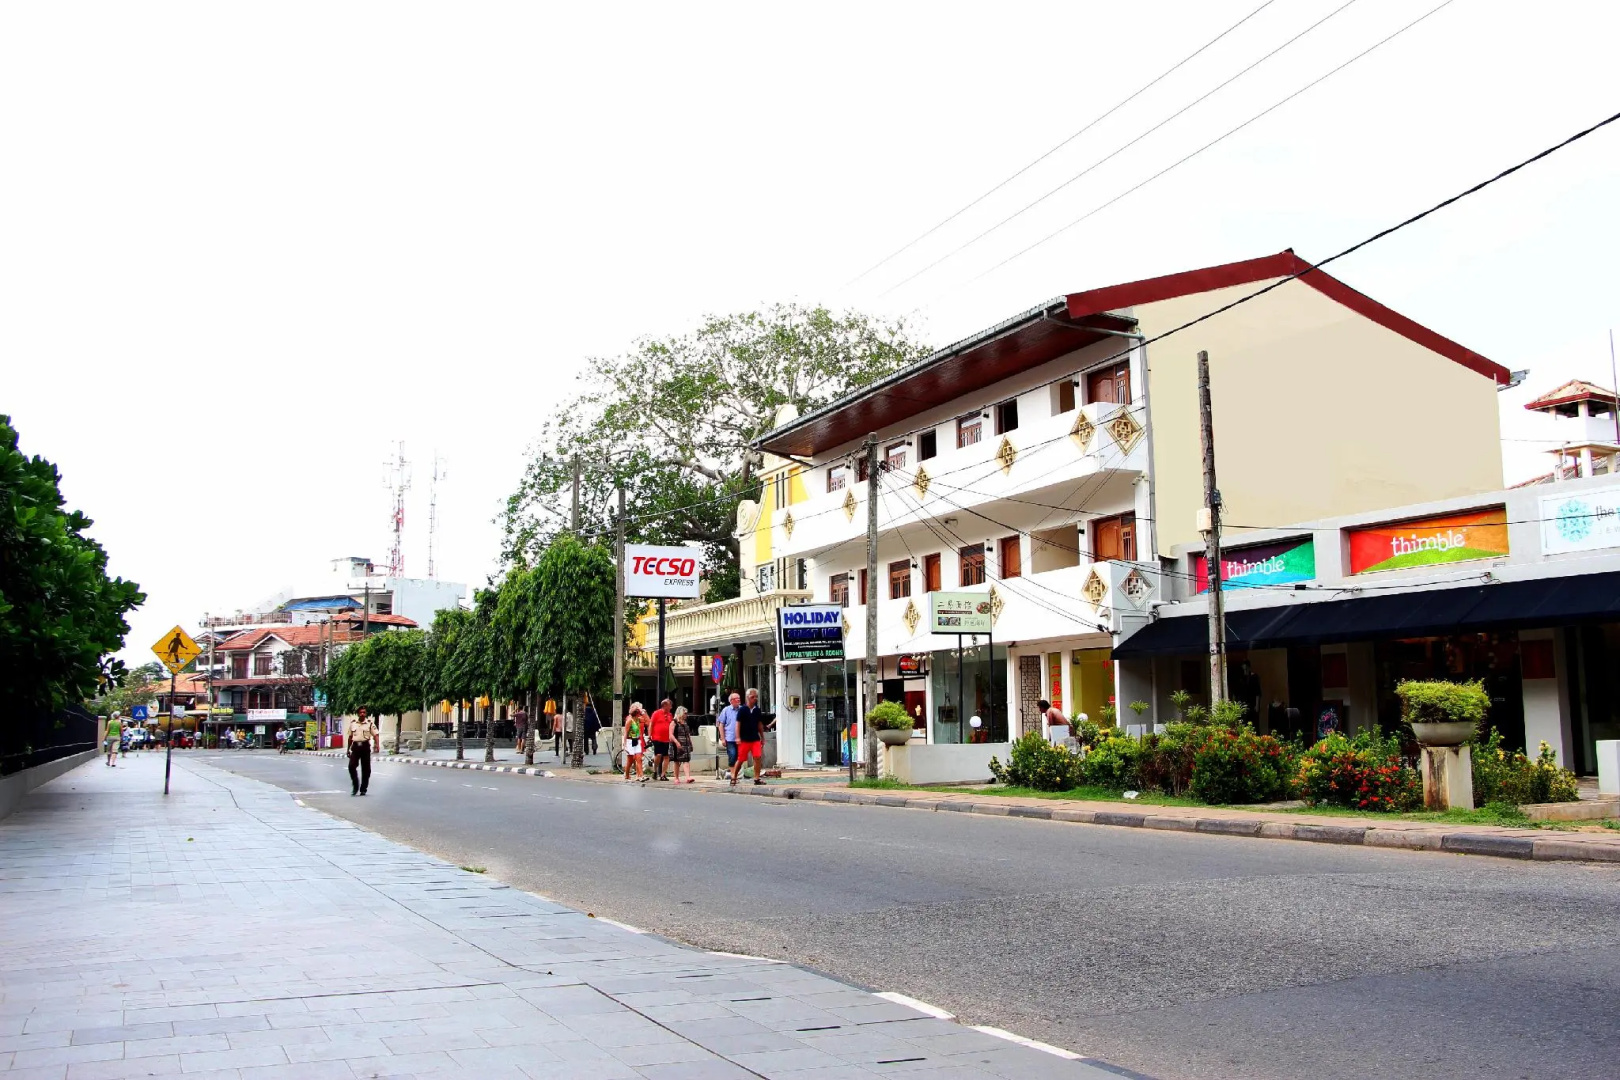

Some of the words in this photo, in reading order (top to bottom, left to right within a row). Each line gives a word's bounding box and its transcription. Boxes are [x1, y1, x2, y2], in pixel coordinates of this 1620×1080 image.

[1390, 530, 1466, 556] thimble
[632, 556, 696, 577] TECSO
[1227, 556, 1286, 579] thimble
[663, 578, 695, 586] EXPRESS
[783, 611, 840, 625] HOLIDAY
